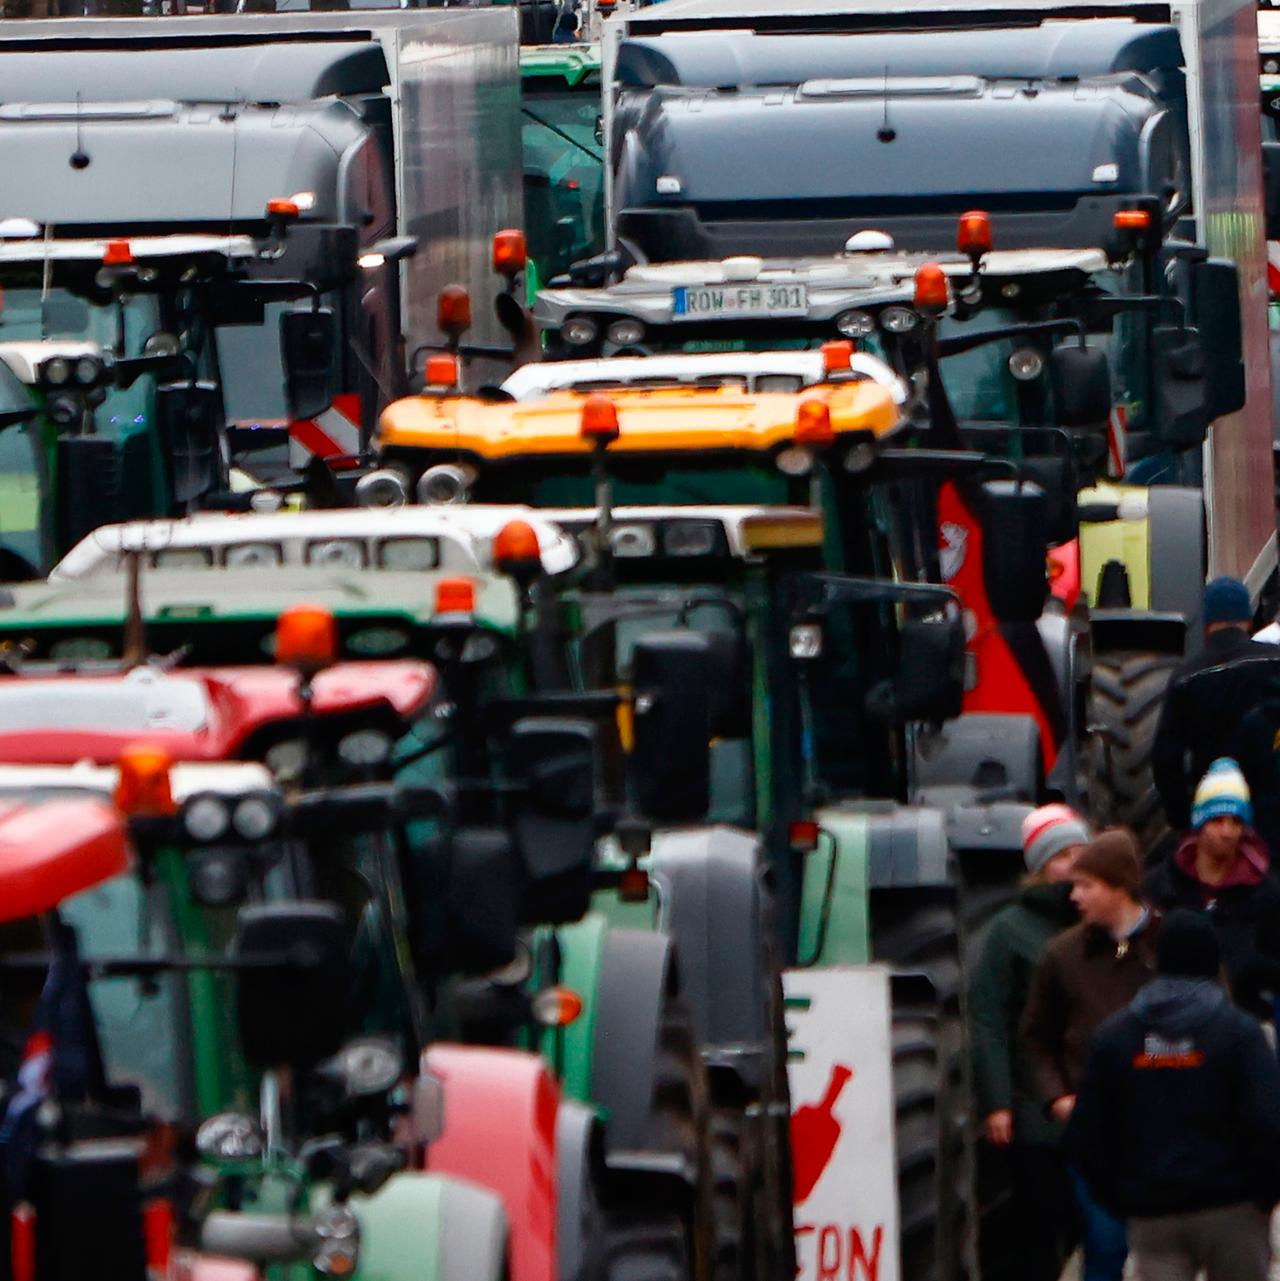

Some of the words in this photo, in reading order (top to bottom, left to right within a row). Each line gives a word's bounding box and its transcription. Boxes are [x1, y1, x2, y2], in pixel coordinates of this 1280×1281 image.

[687, 290, 724, 313] ROW
[737, 288, 762, 309] FH
[767, 286, 802, 309] 301
